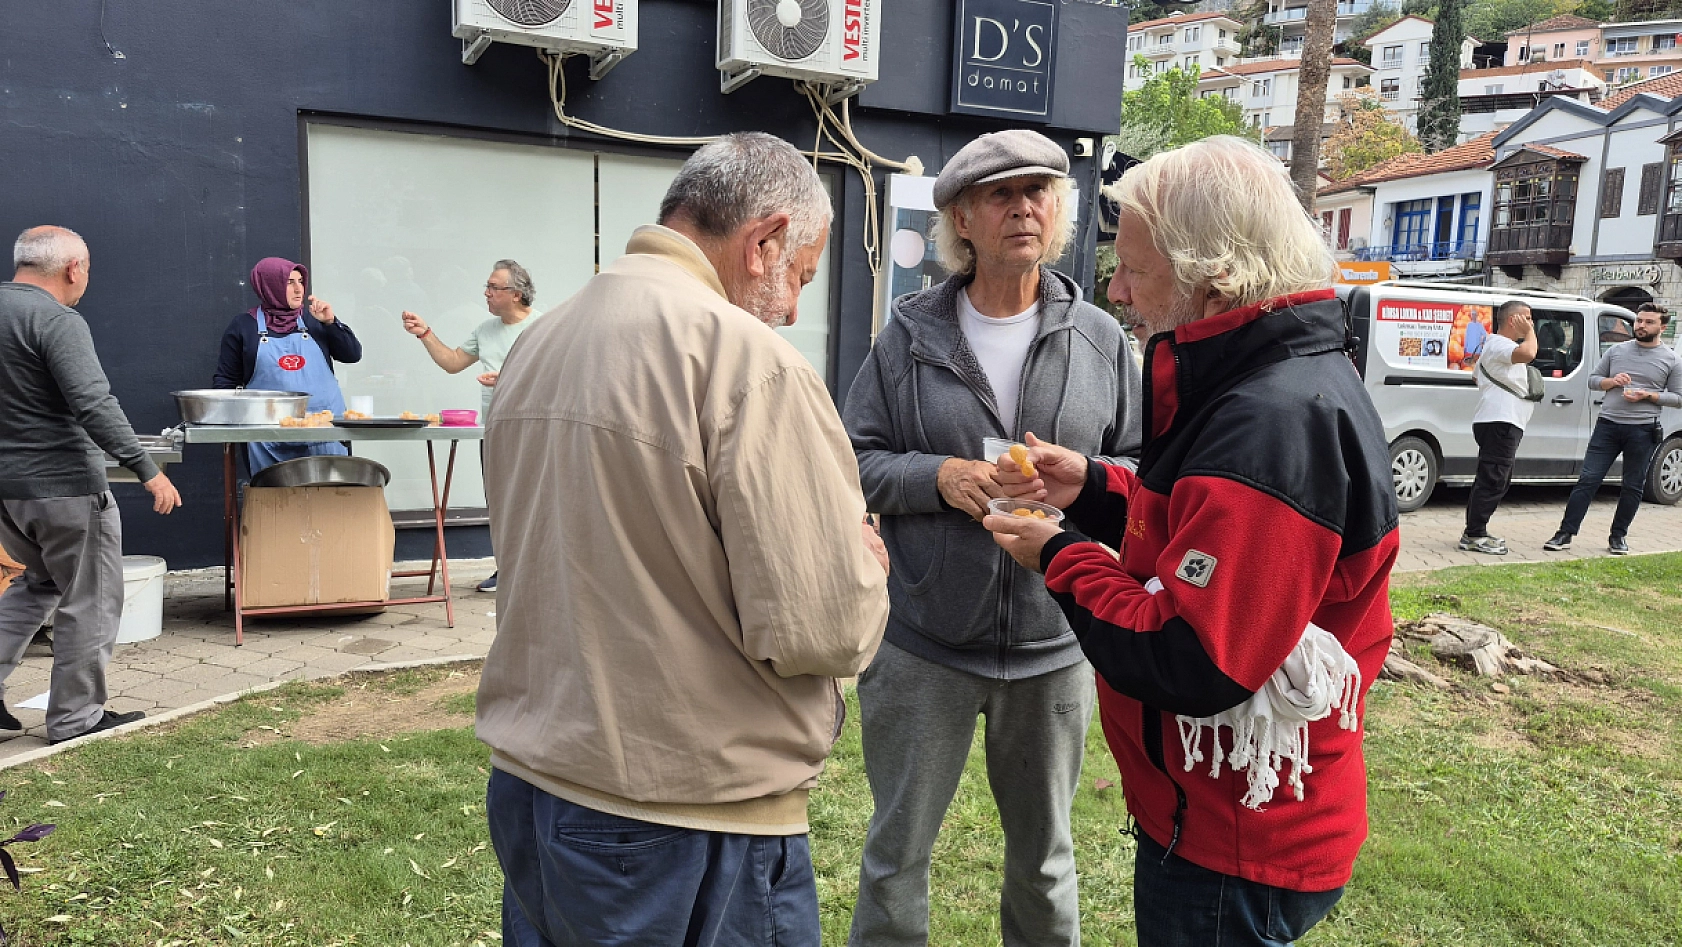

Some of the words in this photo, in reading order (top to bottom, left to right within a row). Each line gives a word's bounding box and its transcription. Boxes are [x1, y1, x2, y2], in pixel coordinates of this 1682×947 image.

[862, 0, 871, 35] inverte
[861, 36, 870, 62] multi
[971, 15, 1044, 67] D'S
[967, 69, 1040, 95] damat
